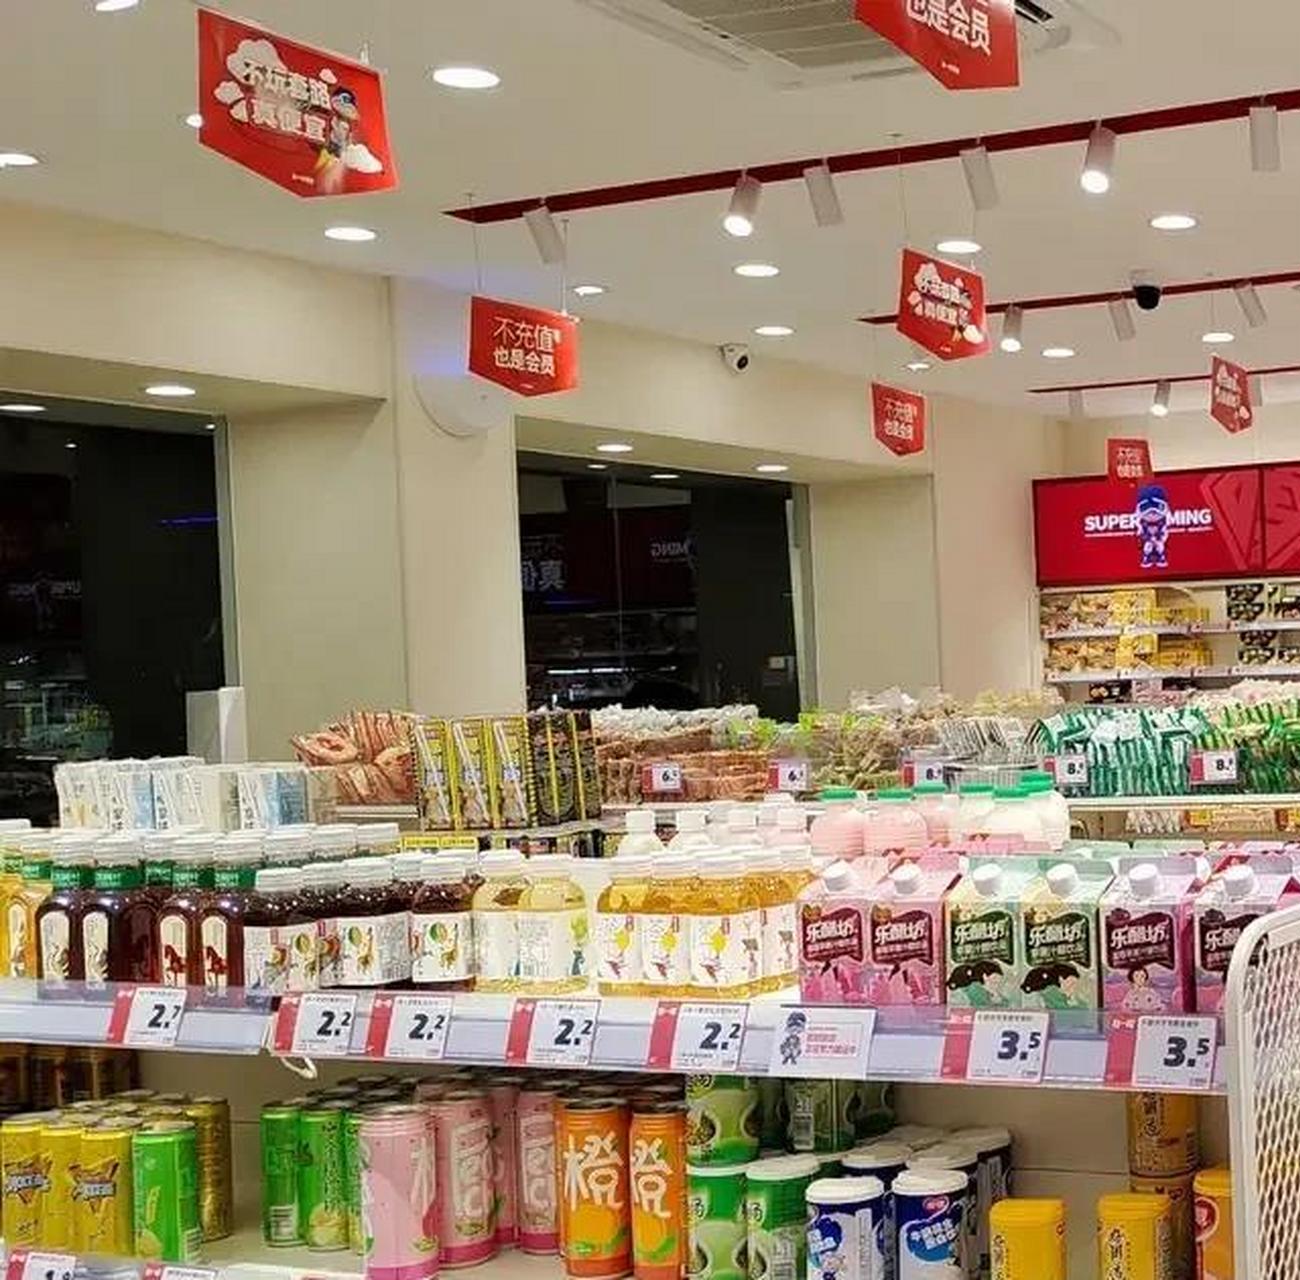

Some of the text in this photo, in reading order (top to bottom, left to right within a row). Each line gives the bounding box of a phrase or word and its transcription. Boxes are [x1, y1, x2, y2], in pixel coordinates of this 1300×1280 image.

[251, 97, 327, 142] 真便宜
[493, 316, 555, 352] 不充值
[493, 346, 555, 377] 也是会员
[1084, 509, 1212, 532] SUPER MING
[148, 1003, 181, 1029] 2.7
[316, 1010, 352, 1037] 2.2
[408, 1013, 446, 1040] 2.2
[555, 1019, 593, 1046] 2.2
[699, 1021, 741, 1050] 2.2
[997, 1030, 1041, 1061] 3.5
[1163, 1036, 1210, 1067] 3.5
[563, 1131, 624, 1211] 橙
